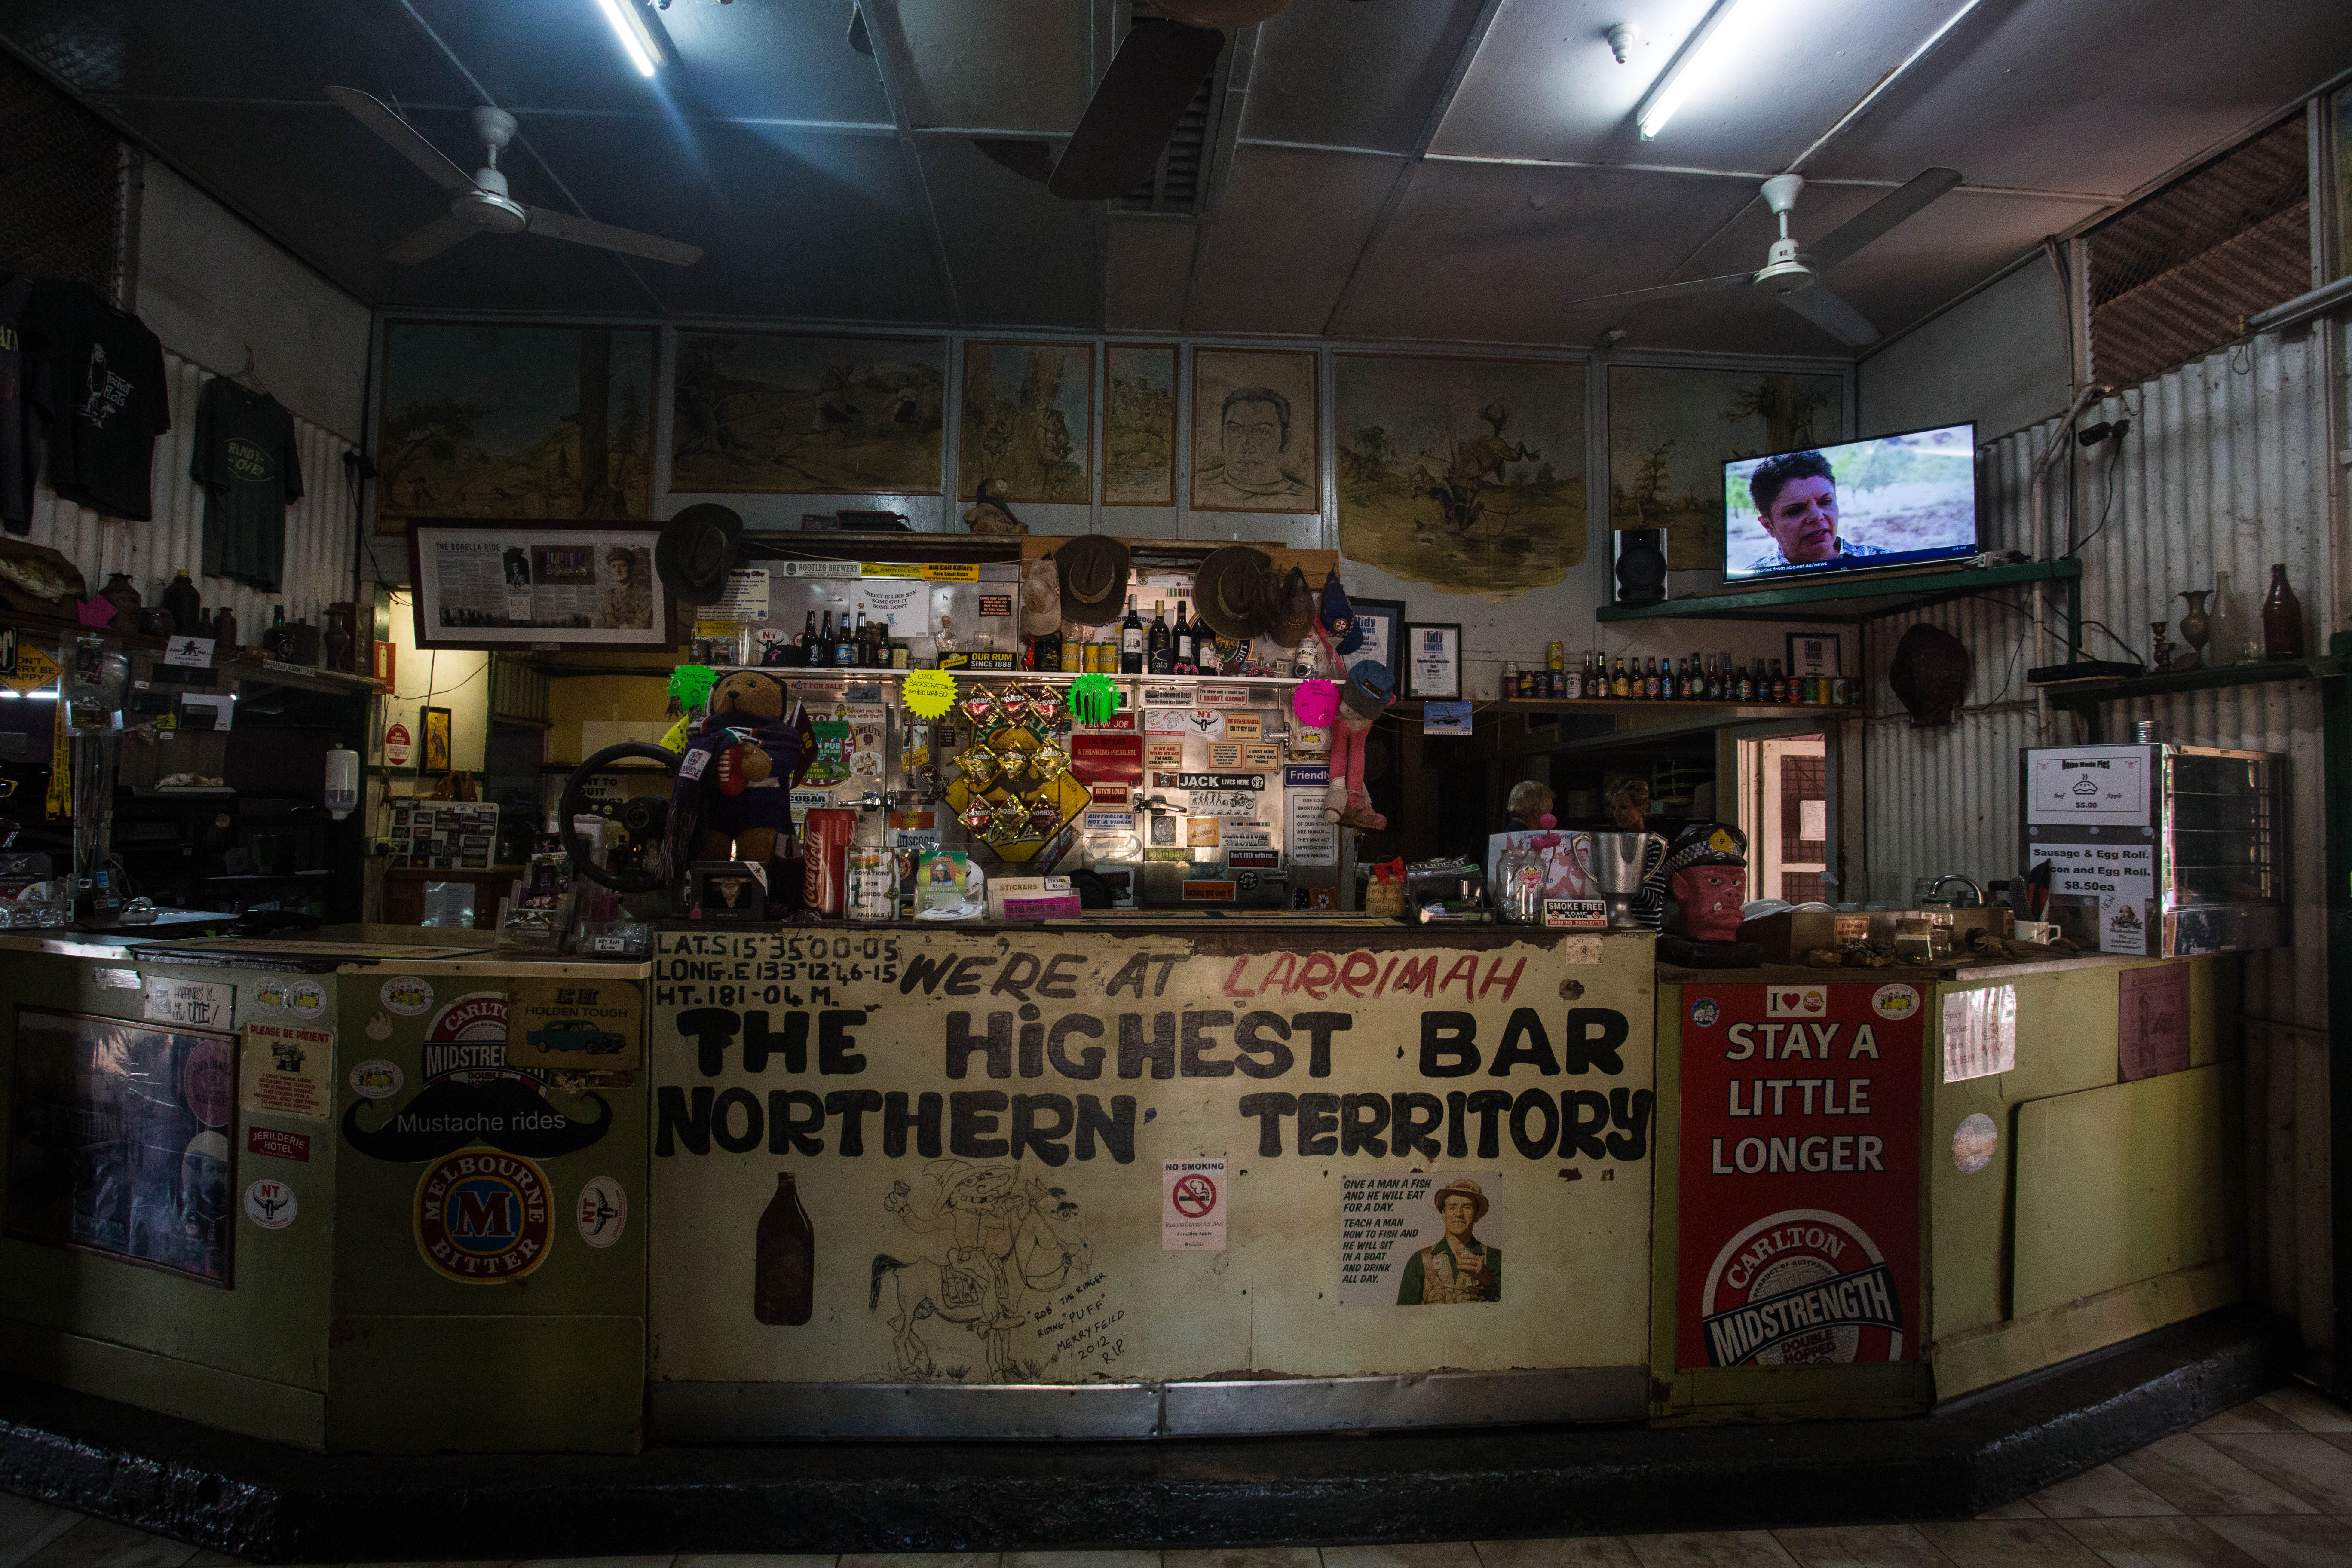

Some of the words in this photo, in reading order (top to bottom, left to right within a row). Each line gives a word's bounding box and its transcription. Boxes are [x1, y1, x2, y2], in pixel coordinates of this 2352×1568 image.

[1786, 562, 1828, 570] abc.net.au/news
[1427, 631, 1443, 643] tidy
[1180, 776, 1219, 787] JACK
[2034, 848, 2080, 858] Sausage
[2097, 850, 2118, 860] Egg
[2123, 851, 2149, 859] Roll.
[2098, 867, 2119, 876] Egg
[2124, 867, 2150, 876] Roll.
[2065, 881, 2115, 891] $8.50ea
[899, 937, 1090, 1002] WE'RE
[1106, 951, 1190, 999] AT
[1223, 952, 1528, 1003] LARRIMAH
[525, 1006, 579, 1017] HOLDEN
[583, 1008, 628, 1018] TOUGH
[251, 1025, 280, 1037] PLEASE
[284, 1029, 294, 1038] BE
[297, 1030, 330, 1042] PATIENT
[676, 1008, 867, 1077] THE
[1418, 1006, 1630, 1078] BAR
[1726, 1022, 1841, 1061] STAY
[1848, 1023, 1881, 1061] A
[1728, 1078, 1872, 1118] LITTLE
[397, 1113, 504, 1134] Mustache
[511, 1112, 566, 1131] rides
[655, 1086, 1137, 1167] NORTHERN
[1238, 1087, 1654, 1161] TERRITORY
[253, 1131, 305, 1149] JERILDERIE
[265, 1141, 292, 1154] HOTEL
[1711, 1134, 1885, 1176] LONGER
[262, 1184, 279, 1198] NT
[424, 1156, 545, 1222] MELBOURNE
[1344, 1180, 1366, 1189] GIVE
[1368, 1179, 1374, 1188] A
[1377, 1179, 1399, 1188] MAN
[1401, 1179, 1408, 1188] A
[1411, 1179, 1432, 1188] FISH
[1344, 1191, 1365, 1200] AND
[1367, 1191, 1378, 1200] HE
[1382, 1191, 1403, 1200] WILL
[1407, 1191, 1425, 1200] EAT
[453, 1191, 516, 1237] M
[582, 1198, 596, 1223] NT
[1344, 1204, 1362, 1212] FOR
[1364, 1203, 1370, 1212] A
[1373, 1203, 1394, 1212] DAY.
[1344, 1219, 1371, 1227] TEACH
[1374, 1219, 1380, 1227] A
[1383, 1219, 1404, 1227] MAN
[1343, 1231, 1363, 1239] HOW
[1366, 1230, 1376, 1239] TO
[1378, 1230, 1397, 1238] FISH
[1400, 1230, 1418, 1238] AND
[1343, 1242, 1354, 1250] HE
[1357, 1241, 1377, 1250] WILL
[1379, 1241, 1394, 1250] SIT
[431, 1238, 540, 1275] BITTER
[1342, 1253, 1353, 1262] IN
[1354, 1253, 1361, 1261] A
[1364, 1253, 1387, 1261] BOAT
[1727, 1226, 1847, 1290] CARLTON
[1343, 1264, 1361, 1272] AND
[1364, 1264, 1391, 1272] DRINK
[1360, 1275, 1378, 1283] DAY.
[1059, 1292, 1074, 1305] THE
[1076, 1272, 1107, 1294] RINGER
[1709, 1270, 1893, 1366] MIDSTRENGTH
[1038, 1322, 1065, 1338] RIDING
[1057, 1326, 1090, 1353] MERRY
[1094, 1310, 1124, 1333] FEILD
[1078, 1336, 1109, 1360] 2012
[1781, 1328, 1834, 1353] DOUBLE
[1783, 1341, 1837, 1364] HOPPED
